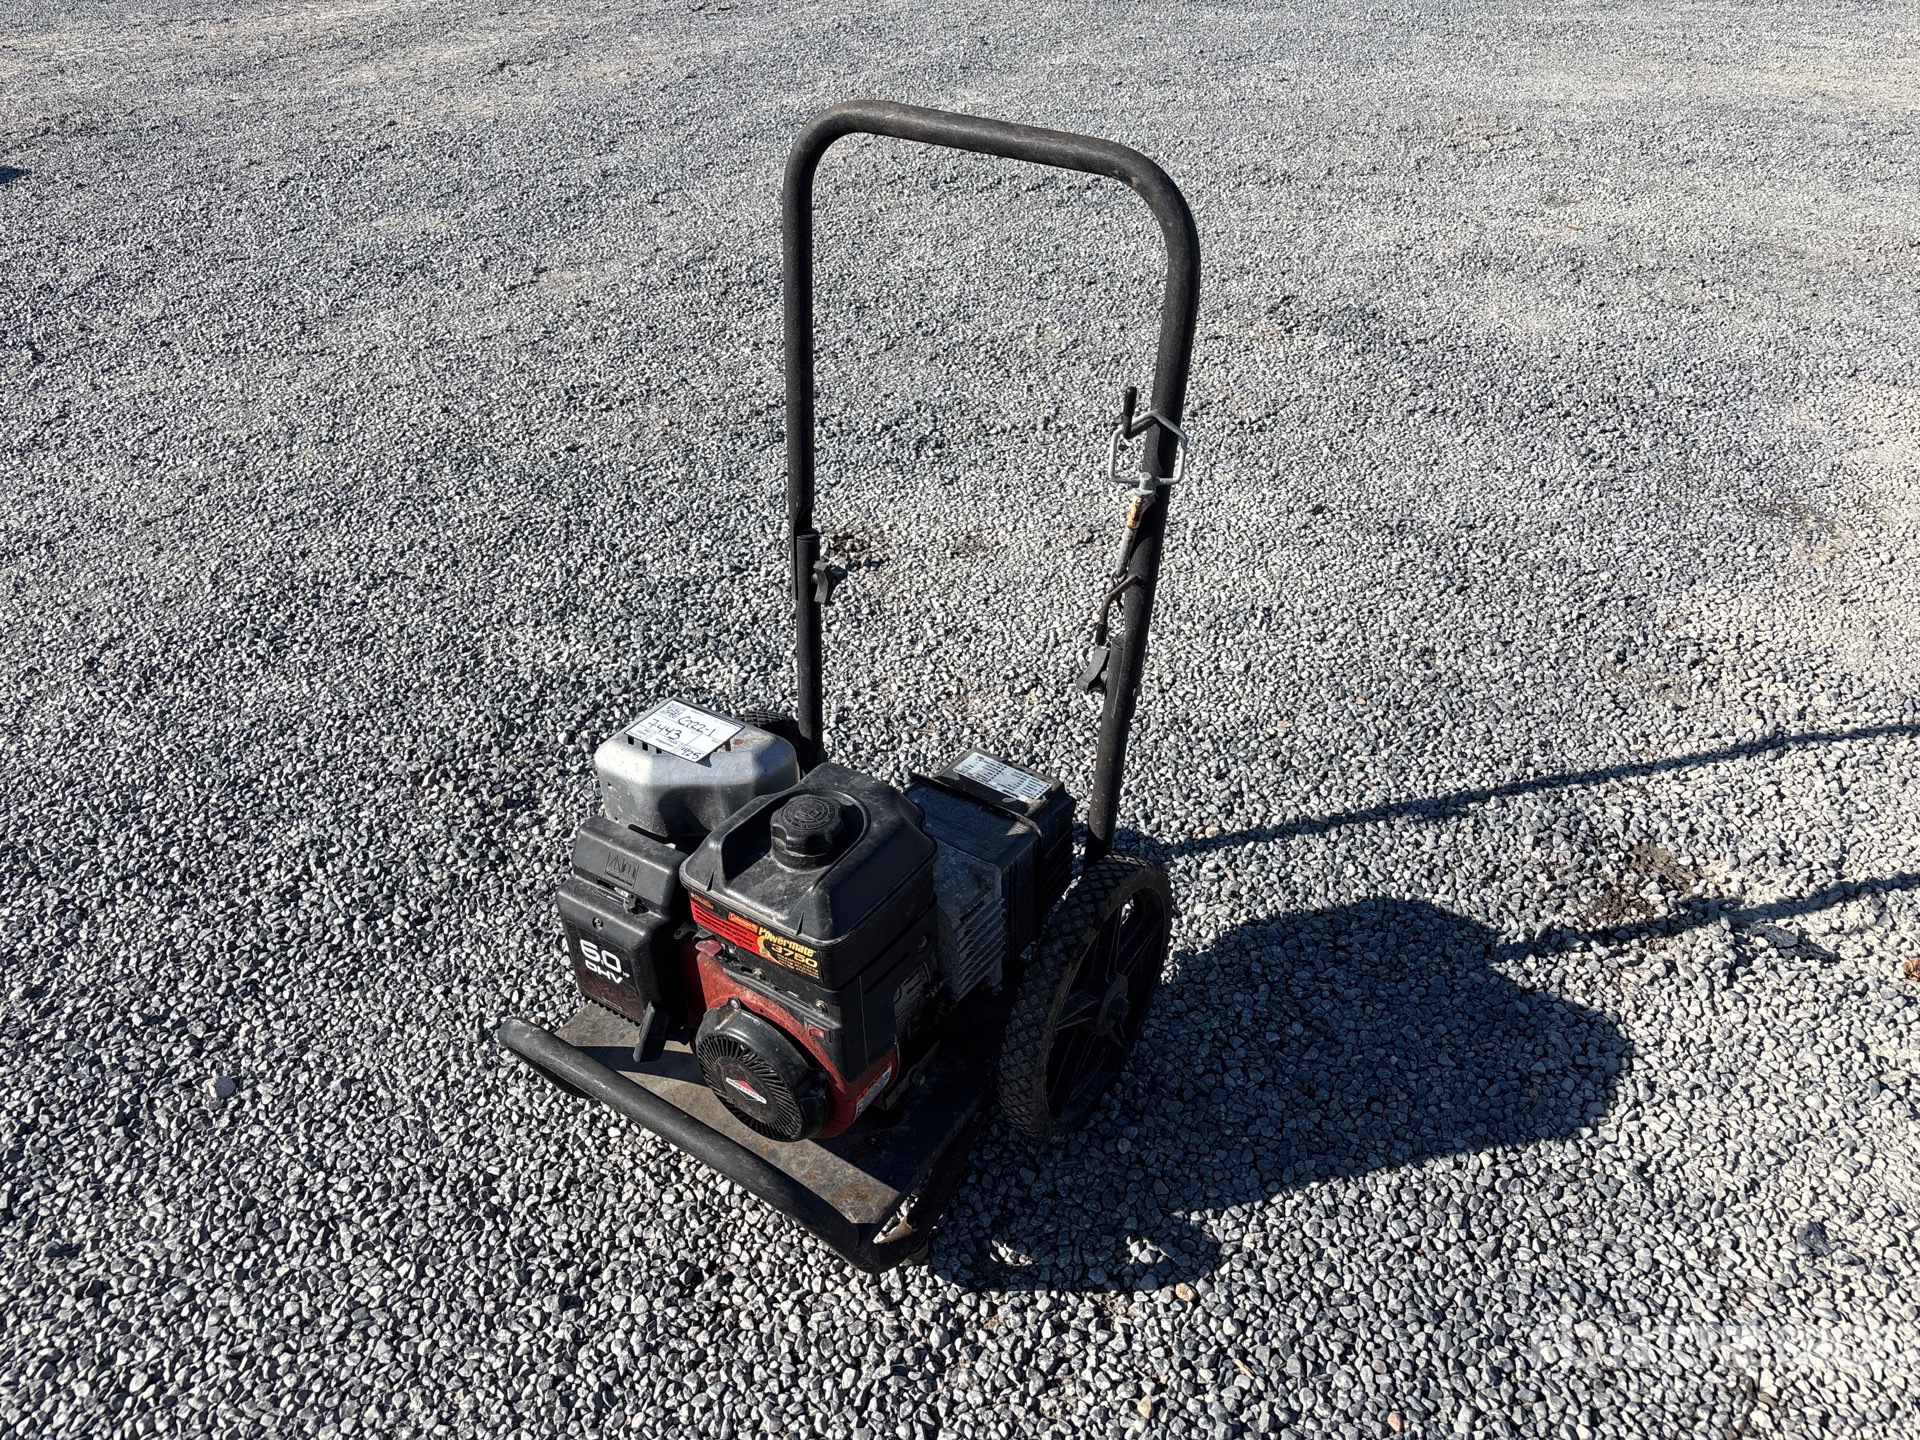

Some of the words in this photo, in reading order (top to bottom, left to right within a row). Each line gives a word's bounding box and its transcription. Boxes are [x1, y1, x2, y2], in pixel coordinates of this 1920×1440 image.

[648, 718, 682, 740] 7443
[758, 926, 814, 957] Powermate
[580, 939, 621, 973] 6.0
[771, 943, 818, 968] 3750
[585, 959, 623, 984] OHV
